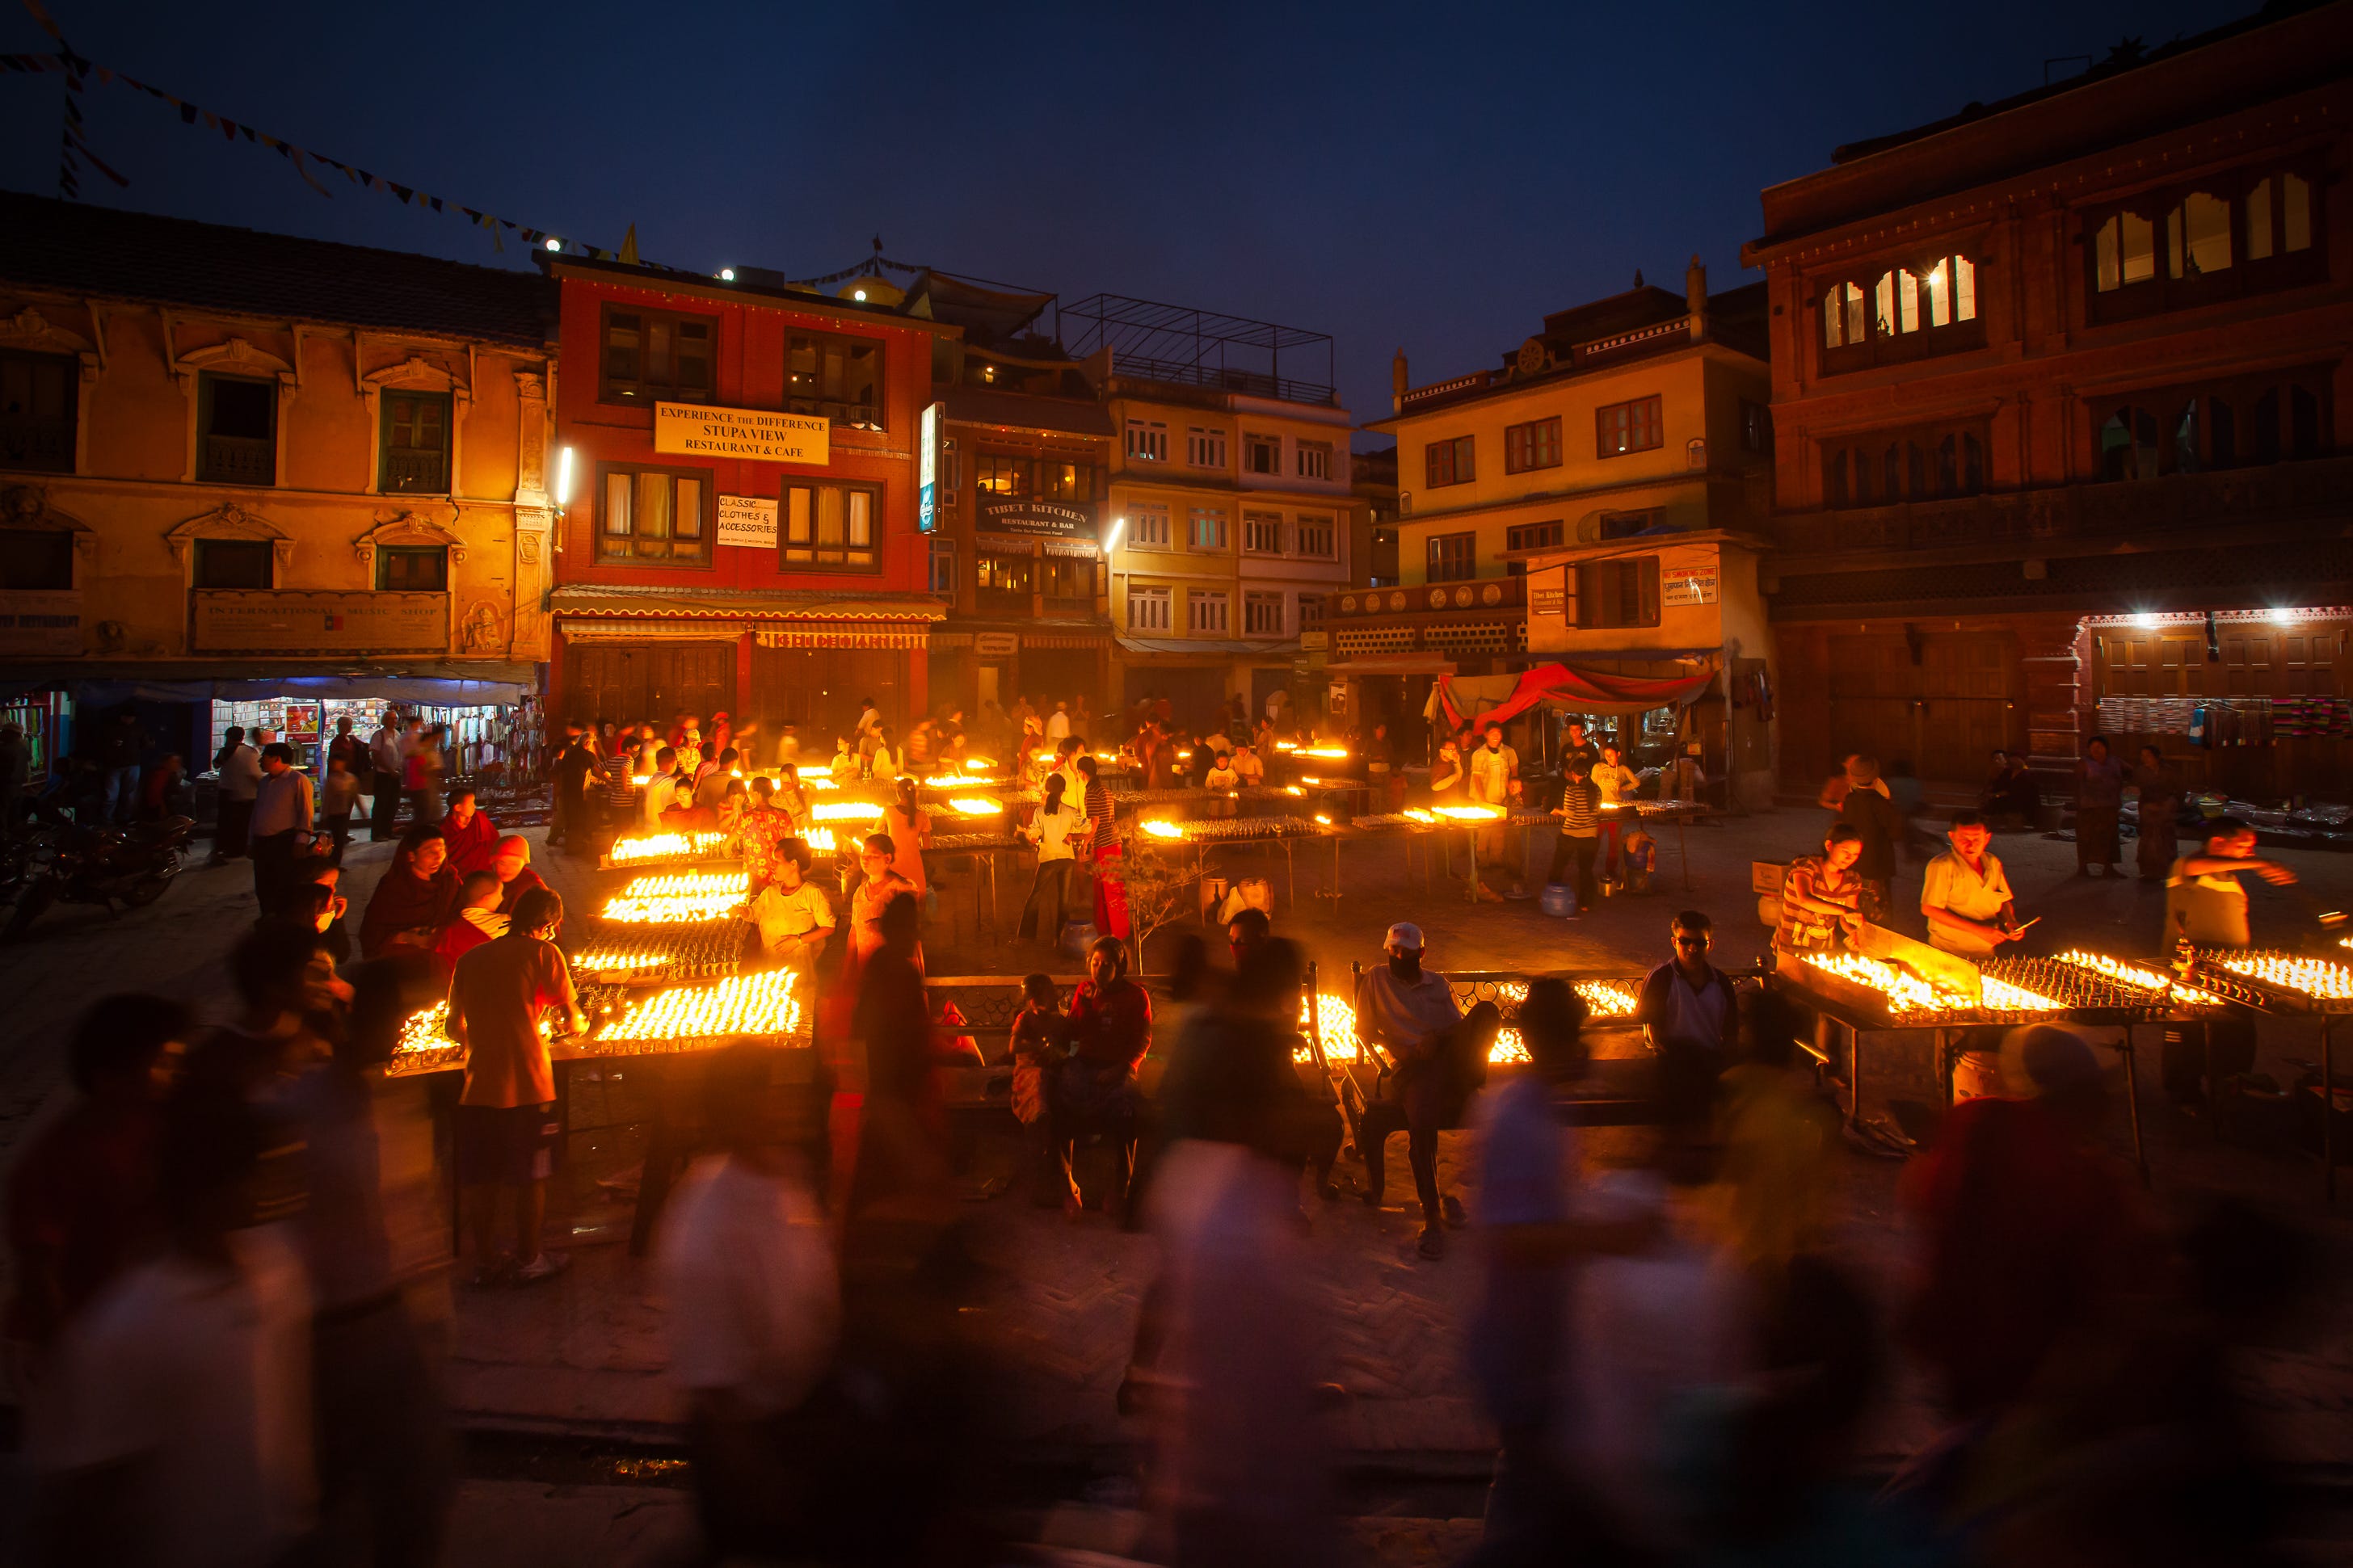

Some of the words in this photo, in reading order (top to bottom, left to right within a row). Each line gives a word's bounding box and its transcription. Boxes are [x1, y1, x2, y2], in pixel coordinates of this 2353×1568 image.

[661, 408, 734, 423] EXPERIENCE
[737, 416, 755, 425] THE
[757, 417, 825, 431] DIFFERENCE
[703, 425, 747, 439] STUPA
[751, 429, 787, 442] VIEW
[685, 439, 760, 454] RESTAURANT
[763, 446, 772, 455] &
[775, 448, 803, 457] CAFE
[719, 498, 756, 508] CLASSIC
[719, 510, 760, 520] CLOTHES
[763, 514, 769, 524] &
[985, 504, 1025, 515] TIBET
[1031, 504, 1088, 523] KITCHEN
[719, 522, 777, 533] ACCESSORIES
[1002, 518, 1050, 528] RESTAURANT
[1672, 569, 1698, 578] SMOKING
[1699, 567, 1715, 575] ZONE
[209, 607, 334, 615] INTERNATIONAL
[401, 607, 438, 616] SHOP
[778, 634, 851, 645] GOLDEN
[857, 636, 902, 646] ARTS
